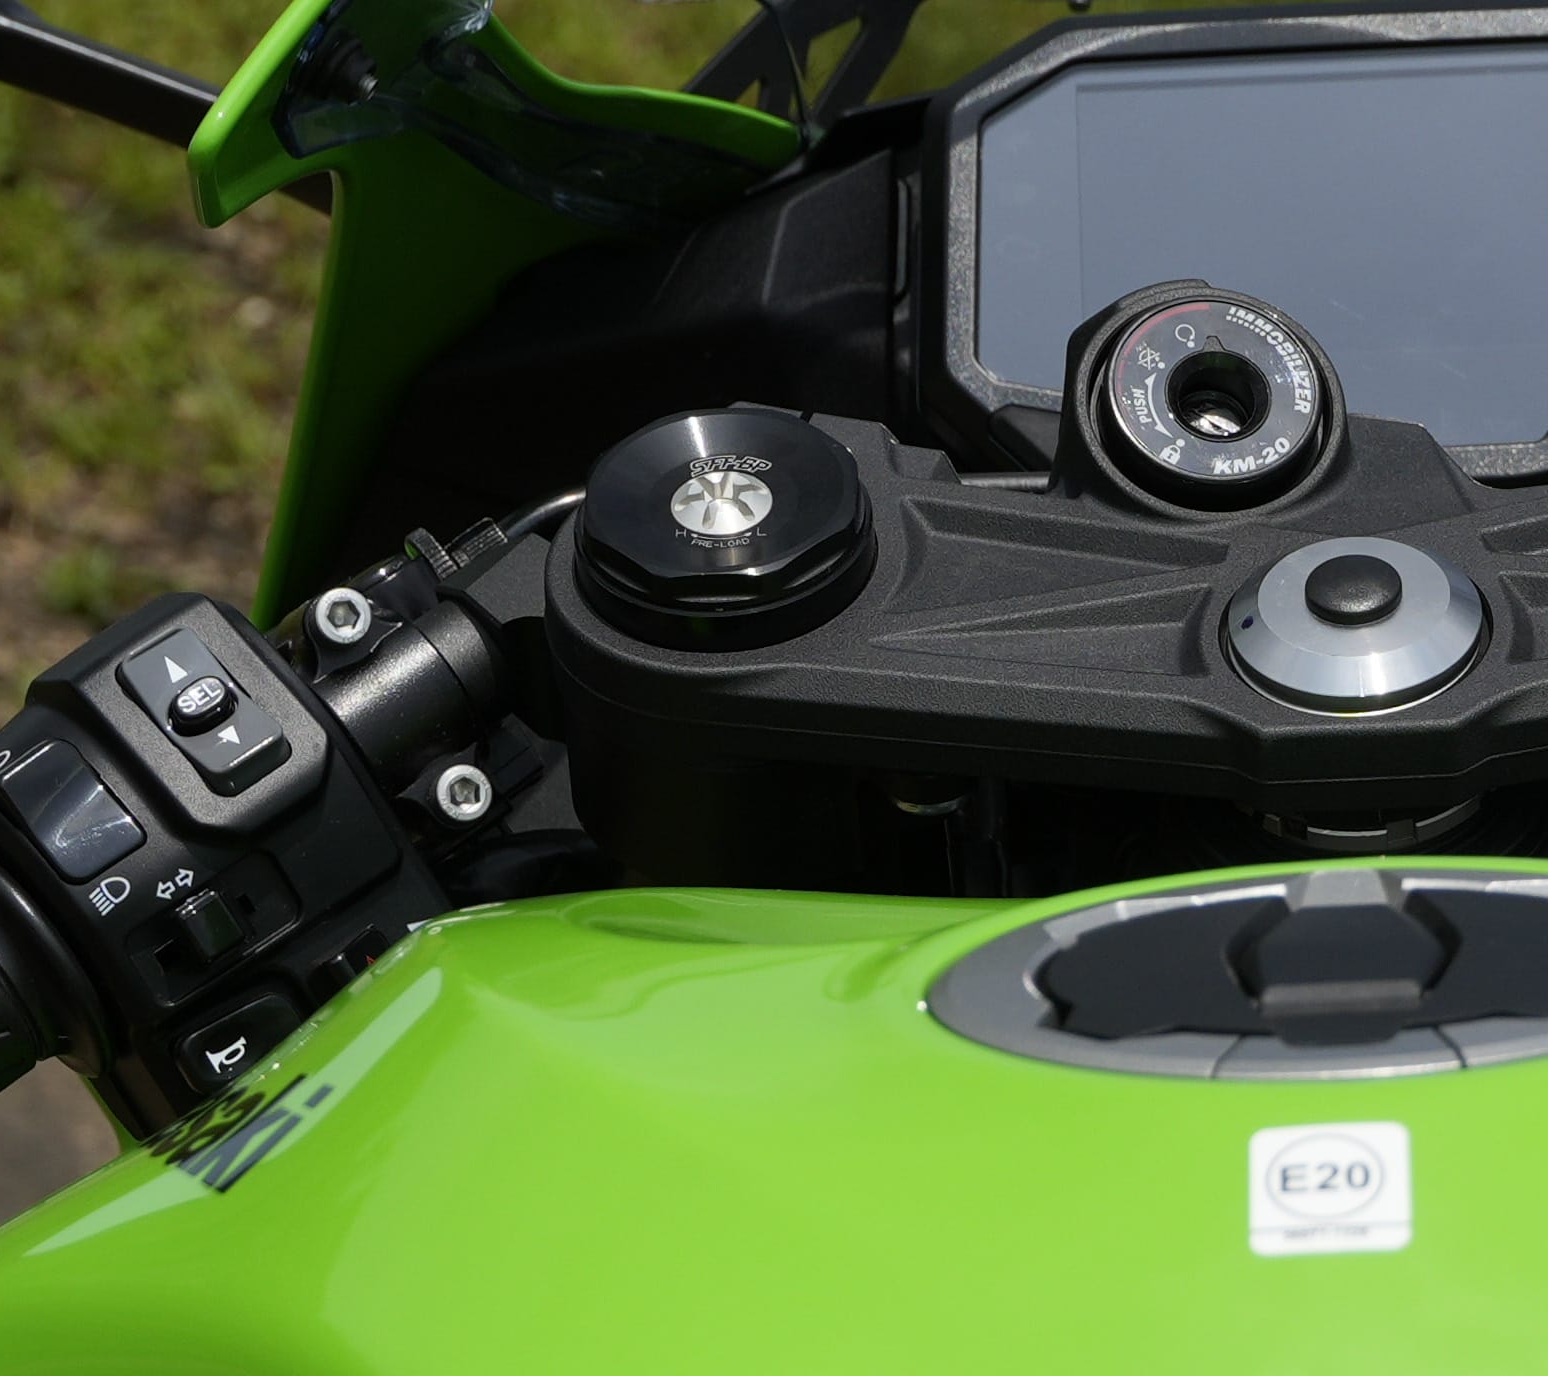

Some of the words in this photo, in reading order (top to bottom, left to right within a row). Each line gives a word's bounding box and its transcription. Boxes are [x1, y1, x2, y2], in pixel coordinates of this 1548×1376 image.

[1226, 307, 1312, 414] IMMOBILIZER
[1132, 386, 1153, 424] PUSH
[1213, 437, 1290, 474] KM-20
[675, 529, 687, 538] H
[756, 527, 767, 536] L
[691, 537, 750, 548] PRE-LOAD
[177, 683, 221, 713] SEL
[1280, 1161, 1370, 1193] E20
